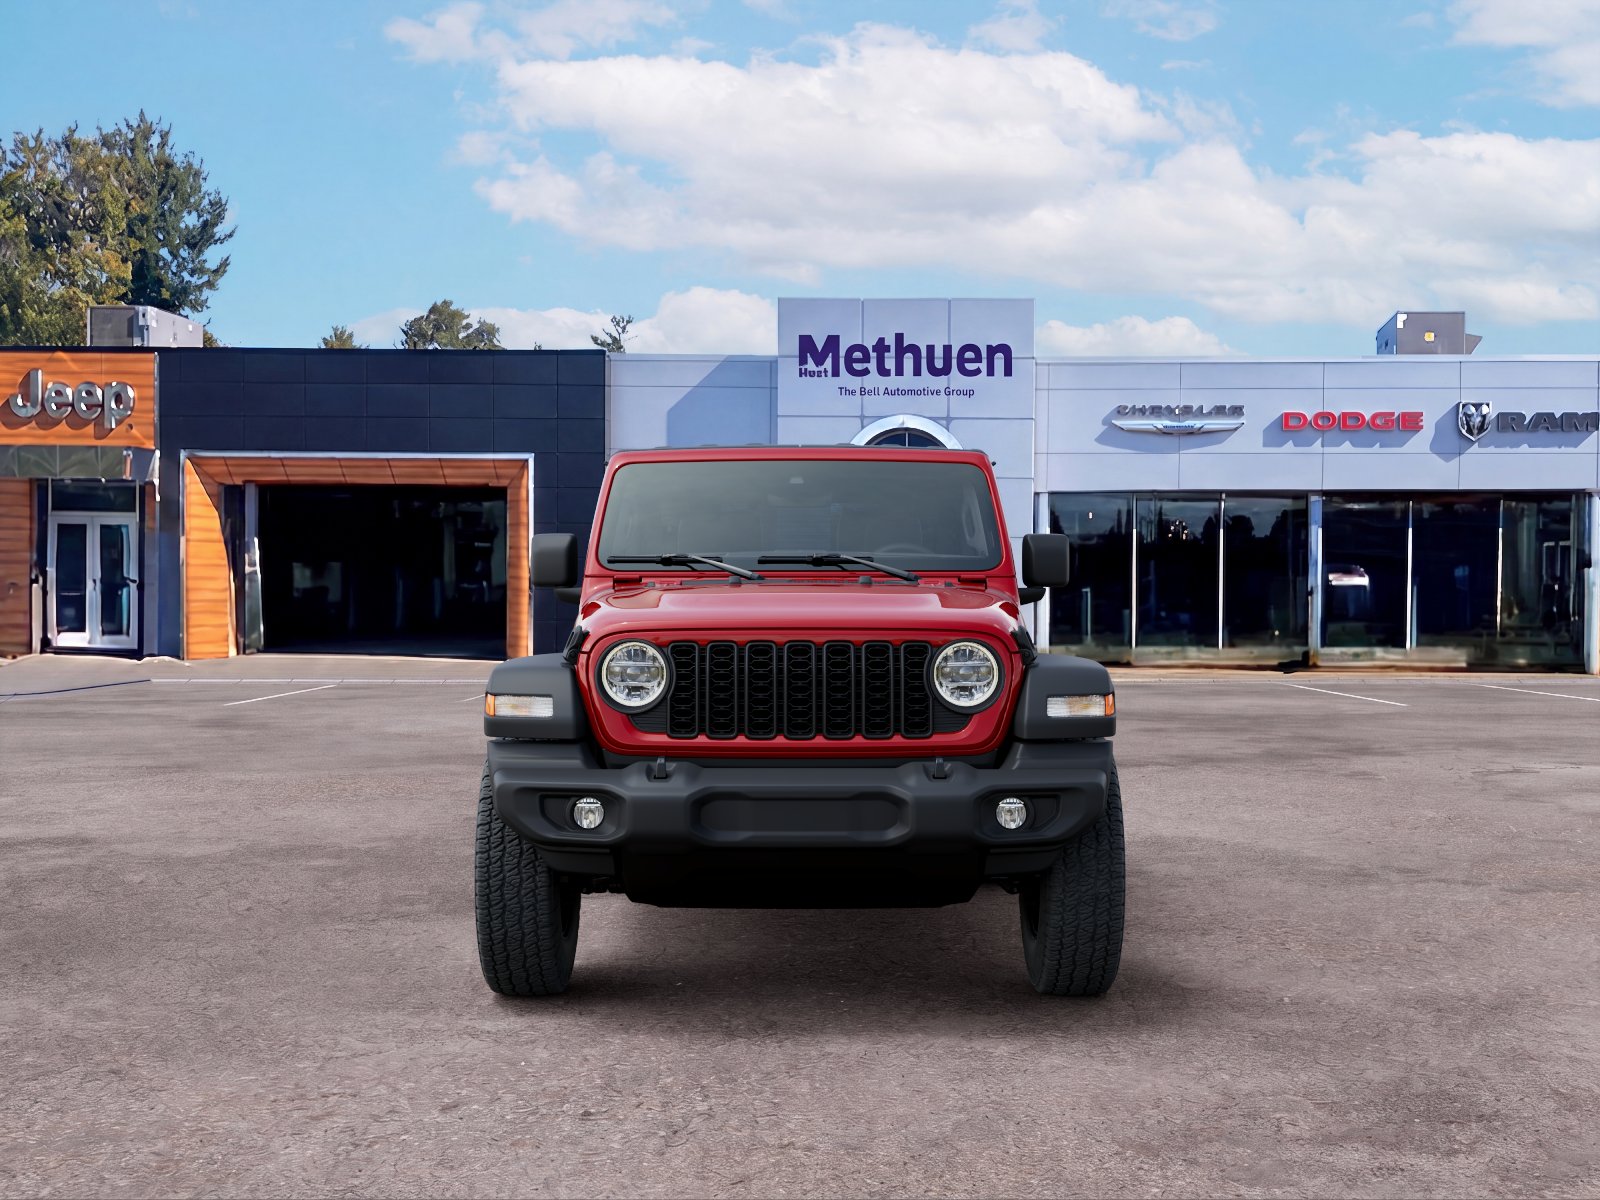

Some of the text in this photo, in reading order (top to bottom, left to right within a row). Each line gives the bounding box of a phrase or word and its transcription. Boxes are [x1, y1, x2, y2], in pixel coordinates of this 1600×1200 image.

[798, 333, 1013, 377] Methuen
[10, 368, 135, 429] Jeep
[838, 386, 975, 398] The Bell Automotive Group
[1282, 411, 1424, 431] DODGE
[1498, 411, 1599, 432] RAM
